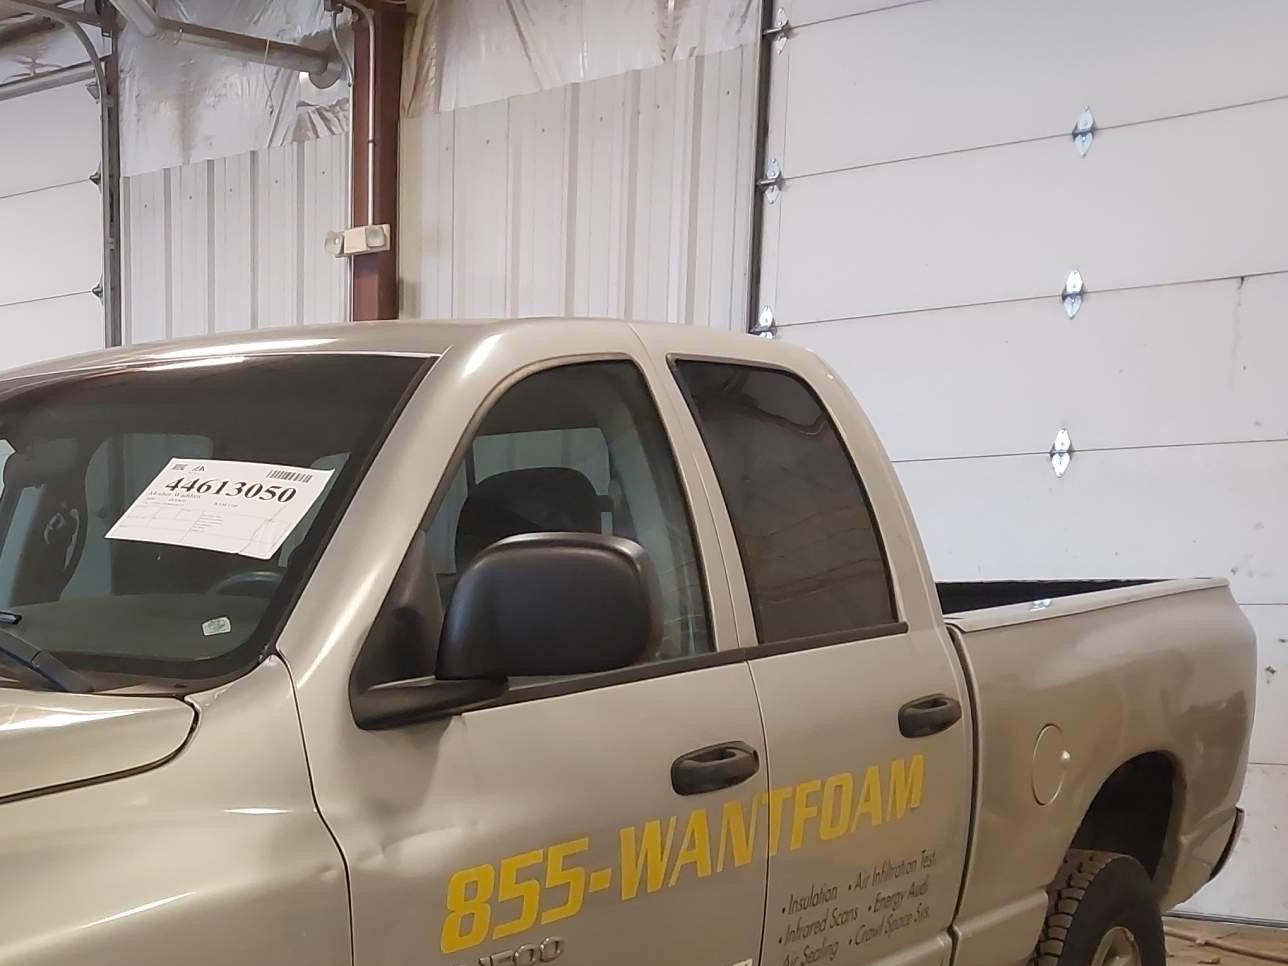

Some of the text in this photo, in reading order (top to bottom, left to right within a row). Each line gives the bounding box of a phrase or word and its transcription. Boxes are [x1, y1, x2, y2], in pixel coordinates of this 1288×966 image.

[165, 477, 298, 503] 44613050
[440, 754, 926, 954] 855-WANTFOAM
[852, 870, 872, 893] Air
[786, 883, 839, 916] Insulation
[872, 890, 906, 914] Energy
[783, 905, 859, 946] Infrared Scans
[799, 937, 840, 966] Sealing
